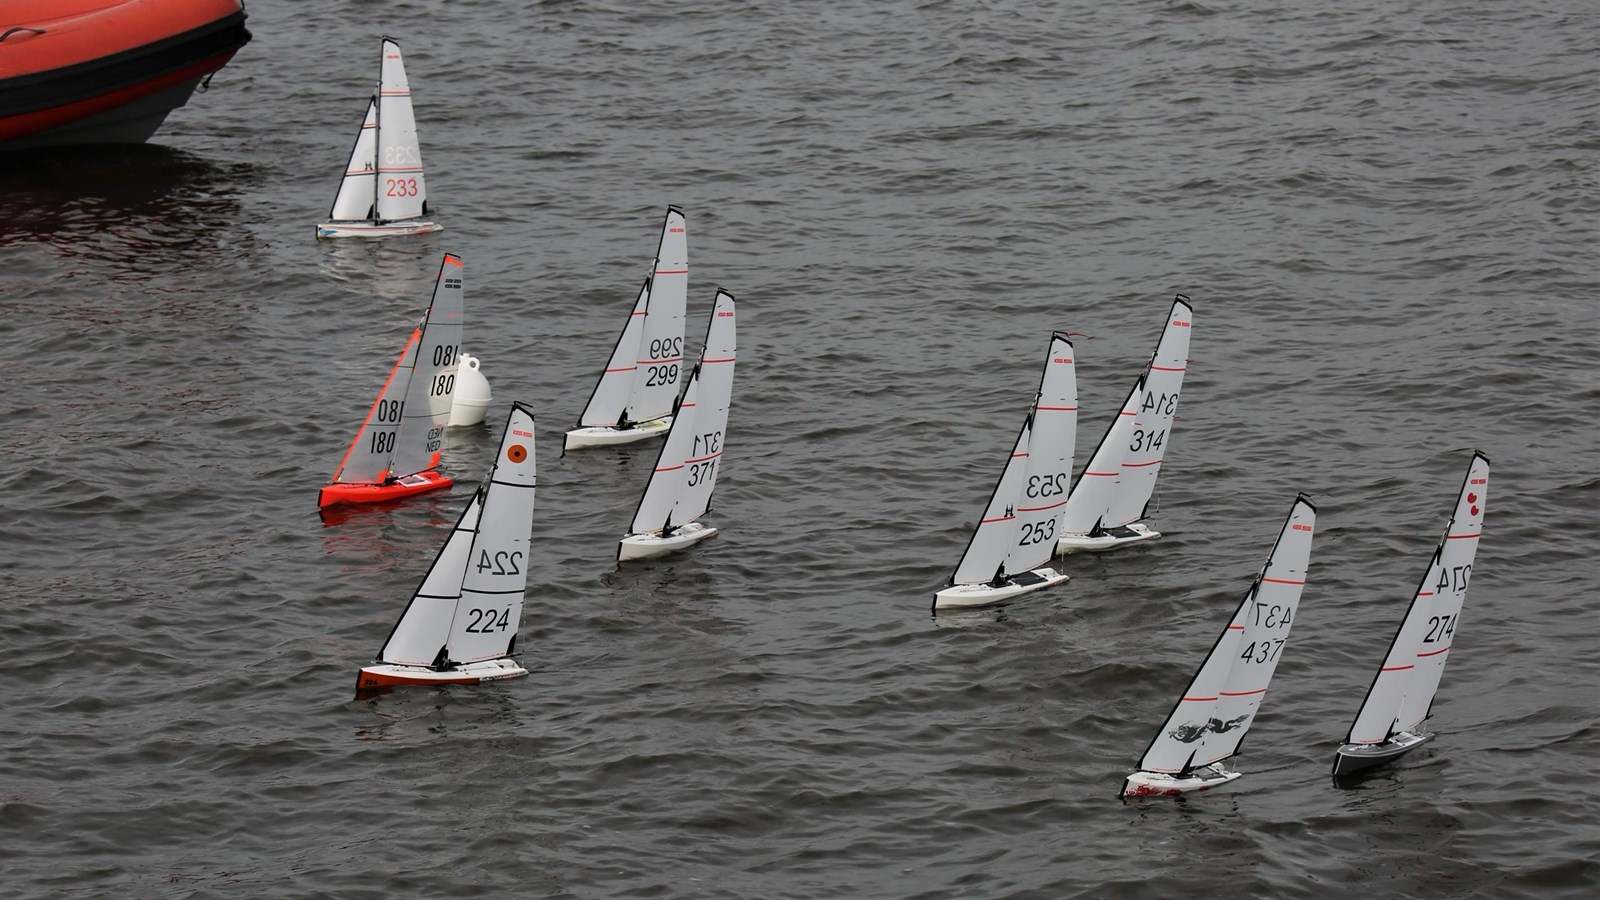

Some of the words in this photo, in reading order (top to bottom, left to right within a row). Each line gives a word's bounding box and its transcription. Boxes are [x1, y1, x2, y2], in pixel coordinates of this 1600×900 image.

[386, 178, 418, 197] 233
[430, 374, 454, 397] 180
[646, 364, 678, 387] 299
[370, 431, 396, 454] 180
[425, 440, 441, 454] NED
[1130, 429, 1166, 452] 314
[688, 459, 716, 487] 371
[1018, 518, 1056, 546] 253
[465, 608, 510, 634] 224
[1423, 613, 1458, 643] 274
[1241, 639, 1285, 664] 437
